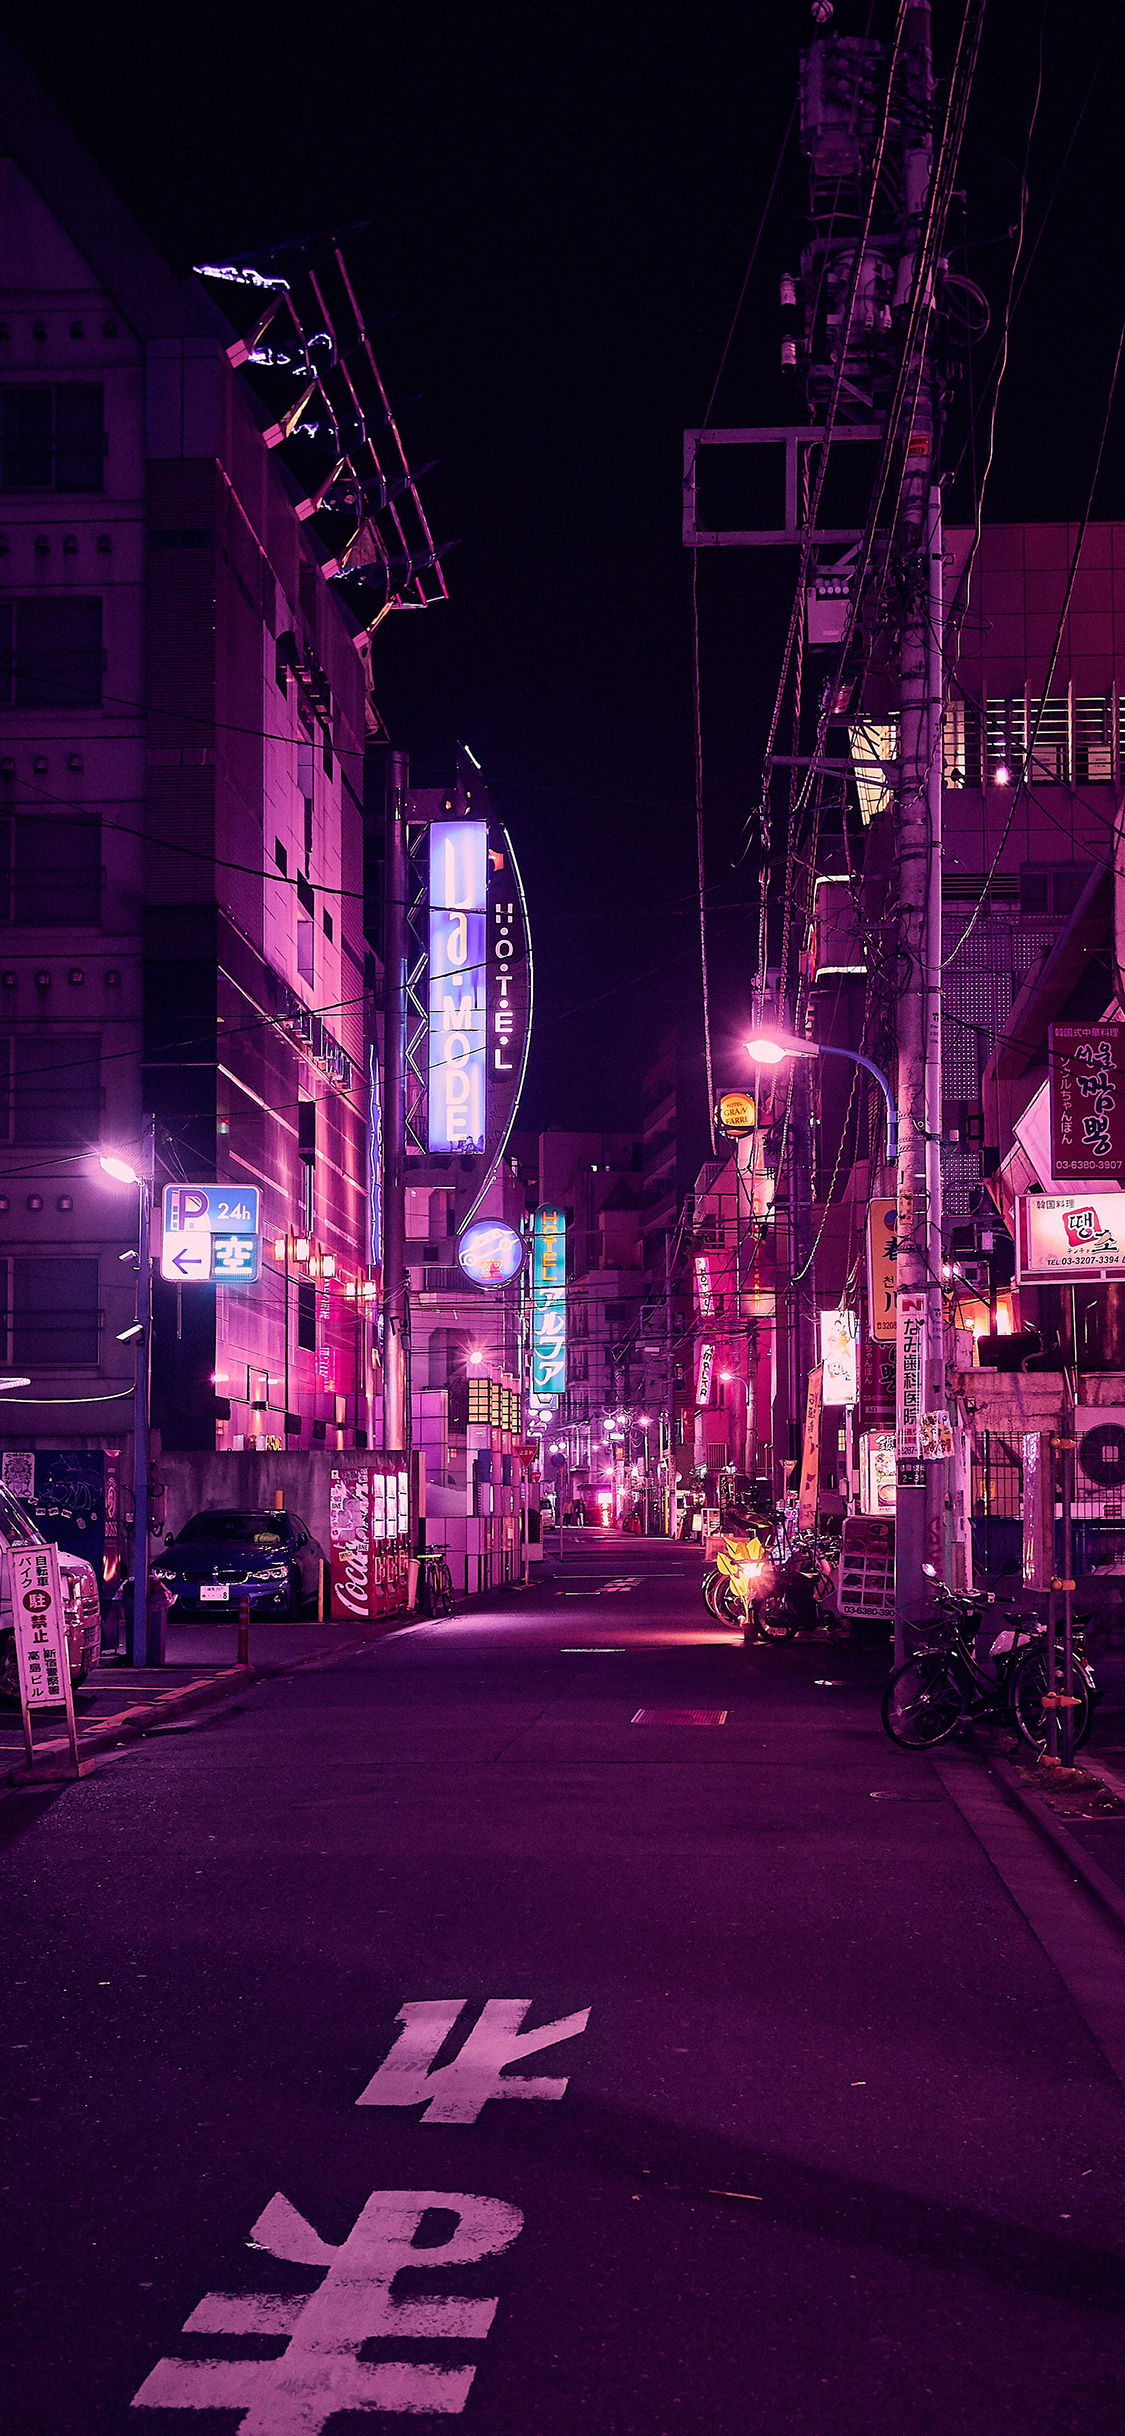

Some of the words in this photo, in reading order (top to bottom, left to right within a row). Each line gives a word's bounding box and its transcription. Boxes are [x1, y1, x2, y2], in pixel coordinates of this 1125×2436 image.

[1055, 1028, 1119, 1037] 韓国式中華料理
[1056, 1160, 1122, 1170] 03-6380-3907
[217, 1202, 251, 1220] 24h
[214, 1235, 254, 1274] 空
[542, 1211, 558, 1281] HOTEL
[19, 1556, 32, 1588] バイク
[35, 1555, 49, 1587] 自転車
